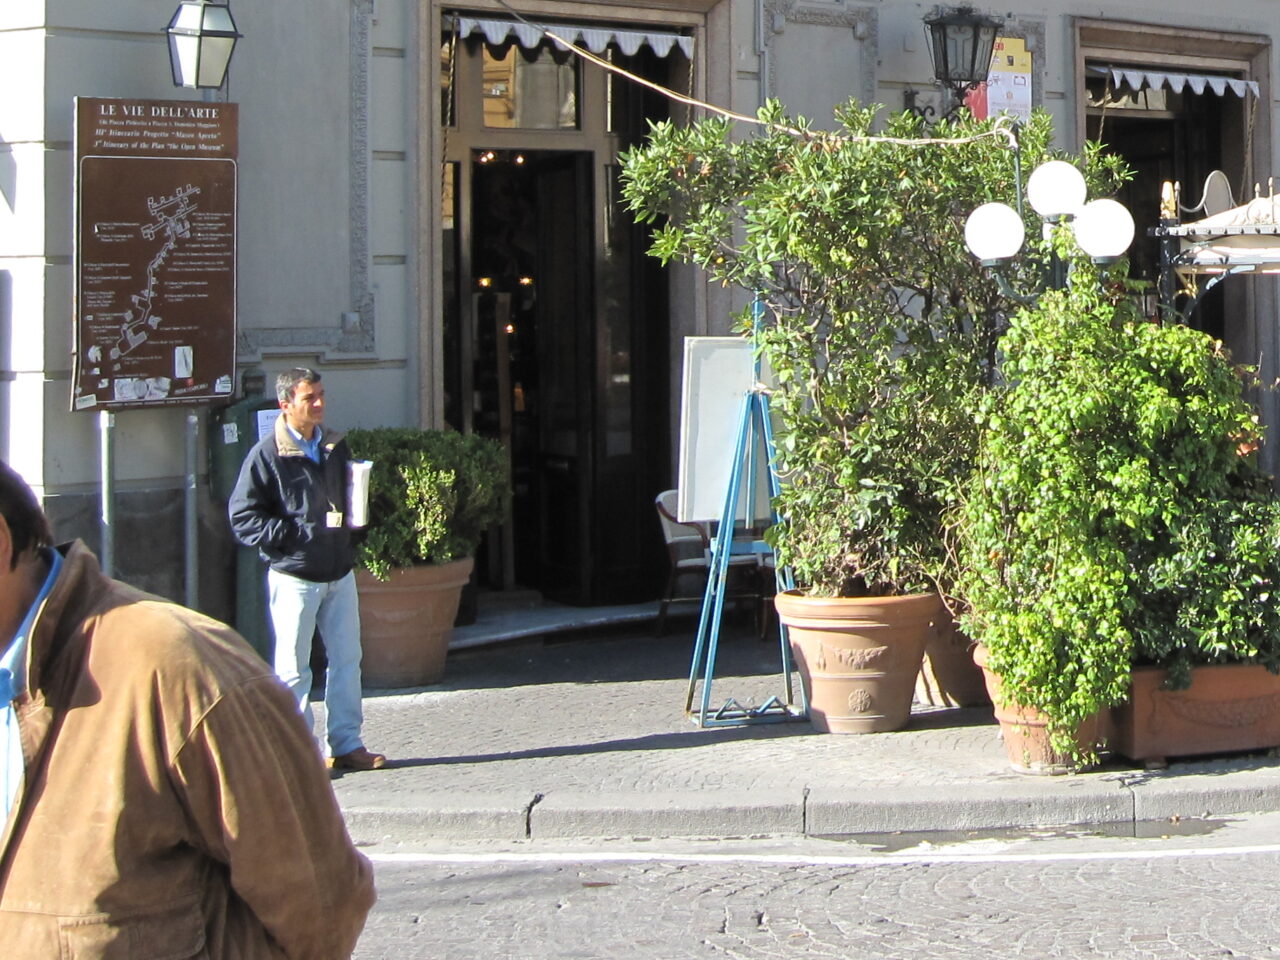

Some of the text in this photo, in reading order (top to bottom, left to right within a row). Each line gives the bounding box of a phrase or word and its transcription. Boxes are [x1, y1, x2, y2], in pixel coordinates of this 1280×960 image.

[100, 105, 219, 119] LE VIE DELL'ARTE
[109, 129, 140, 137] Itinerario
